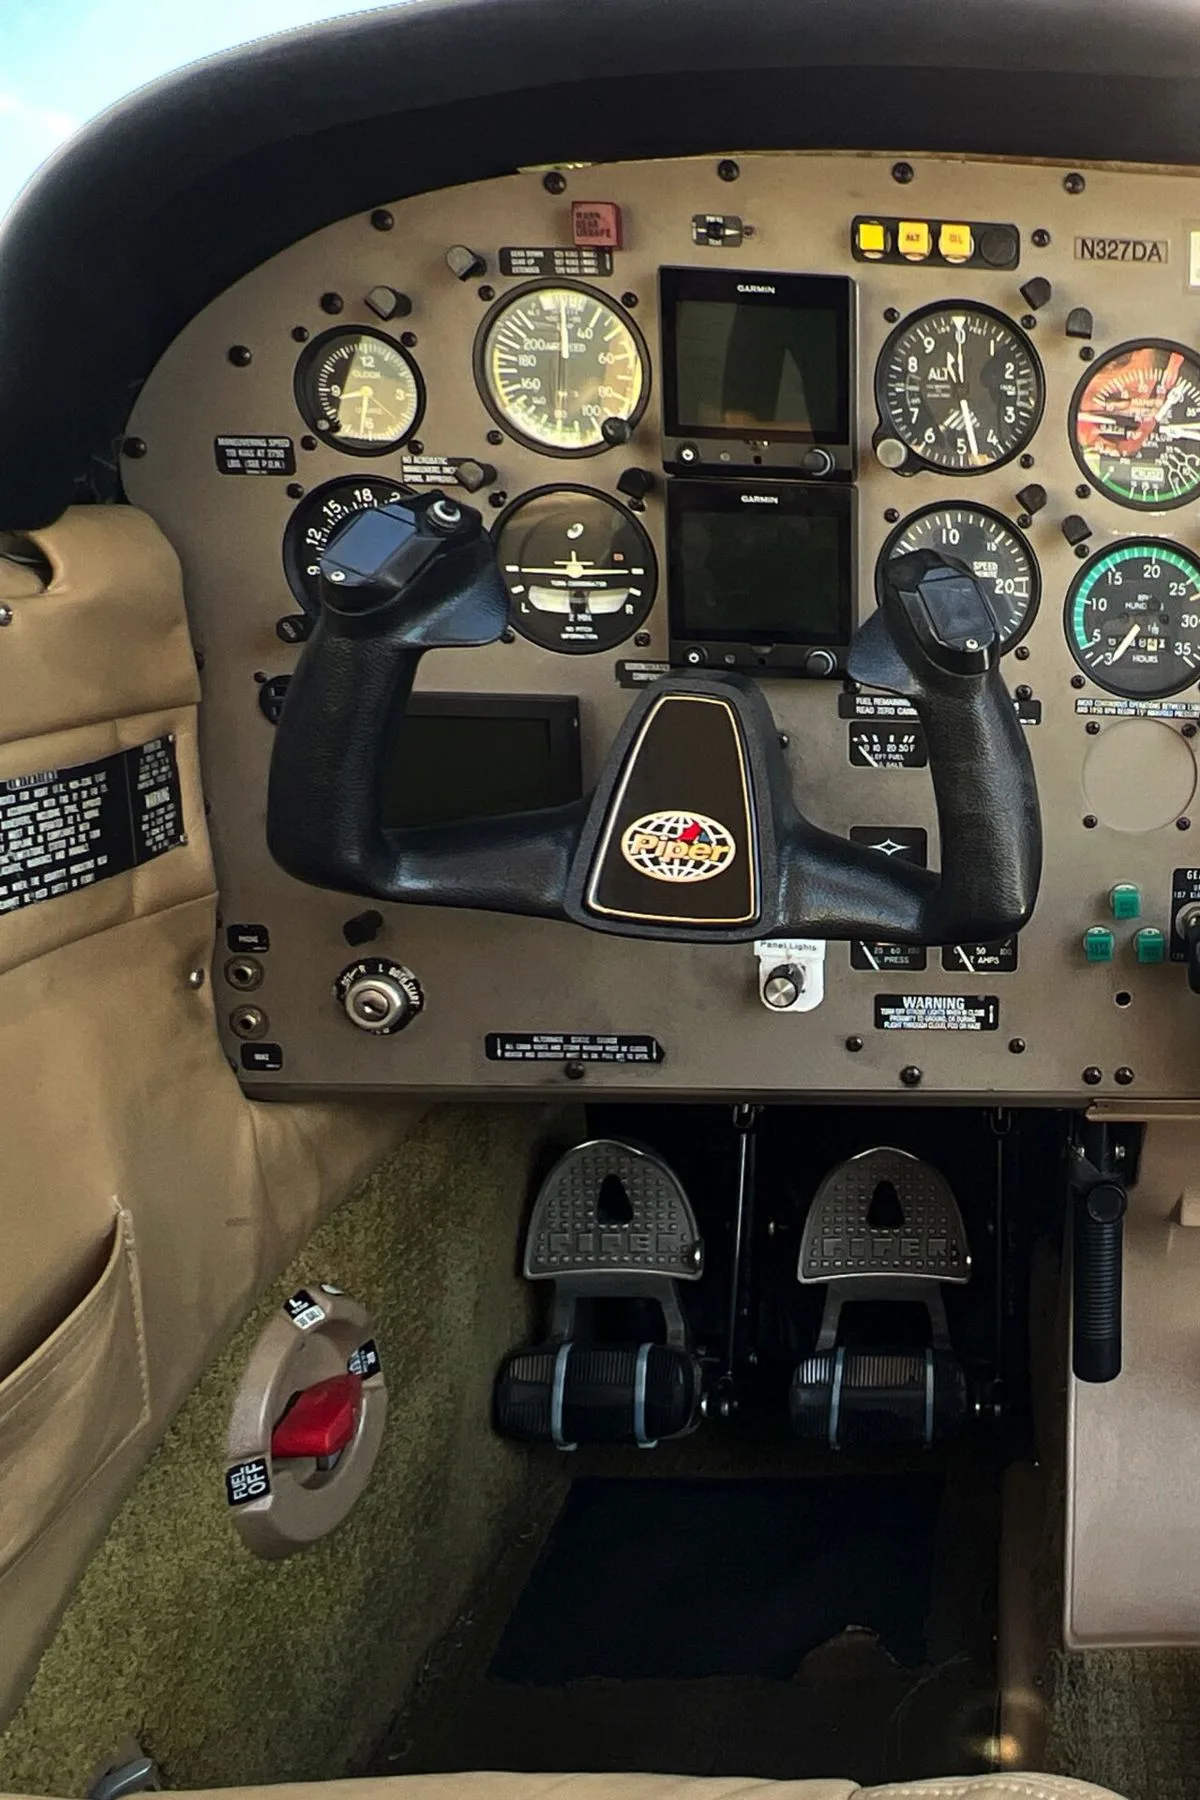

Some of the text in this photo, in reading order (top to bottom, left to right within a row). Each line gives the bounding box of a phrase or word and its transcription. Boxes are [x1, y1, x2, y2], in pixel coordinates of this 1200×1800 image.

[1080, 239, 1161, 261] N327DA
[737, 285, 775, 293] GARMIN
[577, 328, 593, 340] 40
[924, 337, 935, 353] 9
[361, 357, 375, 369] 12
[518, 355, 536, 366] 180
[598, 354, 614, 365] 60
[908, 357, 918, 372] 8
[1005, 362, 1014, 379] 2
[521, 378, 541, 389] 160
[582, 405, 600, 416] 100
[909, 408, 919, 423] 7
[1004, 406, 1015, 423] 3
[924, 428, 935, 443] 6
[987, 429, 997, 445] 4
[957, 438, 966, 454] 5
[354, 488, 374, 501] 18
[741, 495, 778, 504] GARMIN
[322, 500, 342, 517] 15
[305, 528, 322, 545] 12
[942, 529, 960, 544] 10
[307, 565, 320, 575] 9
[973, 562, 998, 571] SPEED
[1143, 565, 1160, 578] 20
[1107, 571, 1122, 586] 15
[995, 579, 1014, 594] 20
[1169, 583, 1186, 595] 25
[1092, 598, 1107, 611] 10
[1181, 615, 1198, 627] 30
[1093, 629, 1101, 641] 5
[1175, 643, 1191, 655] 35
[1132, 655, 1159, 663] HOURS
[856, 697, 912, 706] FUEL REMAININ
[877, 707, 895, 715] ZERO
[631, 832, 731, 863] Piper
[760, 942, 817, 952] Panel Lights
[884, 956, 909, 964] PRESS
[978, 956, 1000, 964] AMPS
[903, 997, 965, 1009] WARNING
[231, 1467, 247, 1501] FUEL
[247, 1462, 264, 1495] OFF
